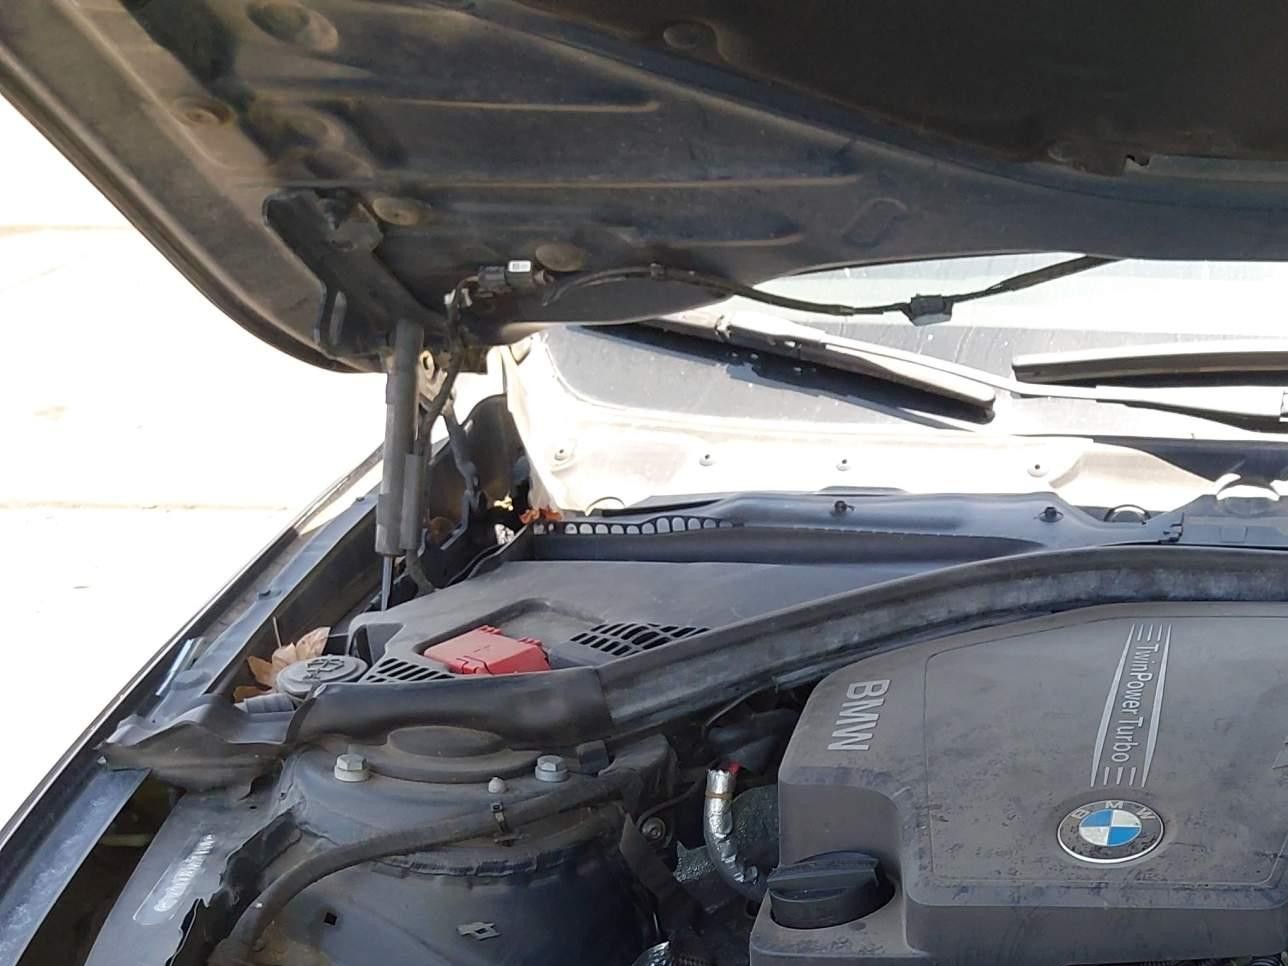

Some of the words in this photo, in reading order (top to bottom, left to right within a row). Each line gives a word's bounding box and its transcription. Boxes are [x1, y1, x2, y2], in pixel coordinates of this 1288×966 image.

[1121, 643, 1160, 714] TwinPower
[827, 679, 891, 752] BMW
[1111, 716, 1144, 763] Turbo
[1070, 800, 1156, 820] BMW
